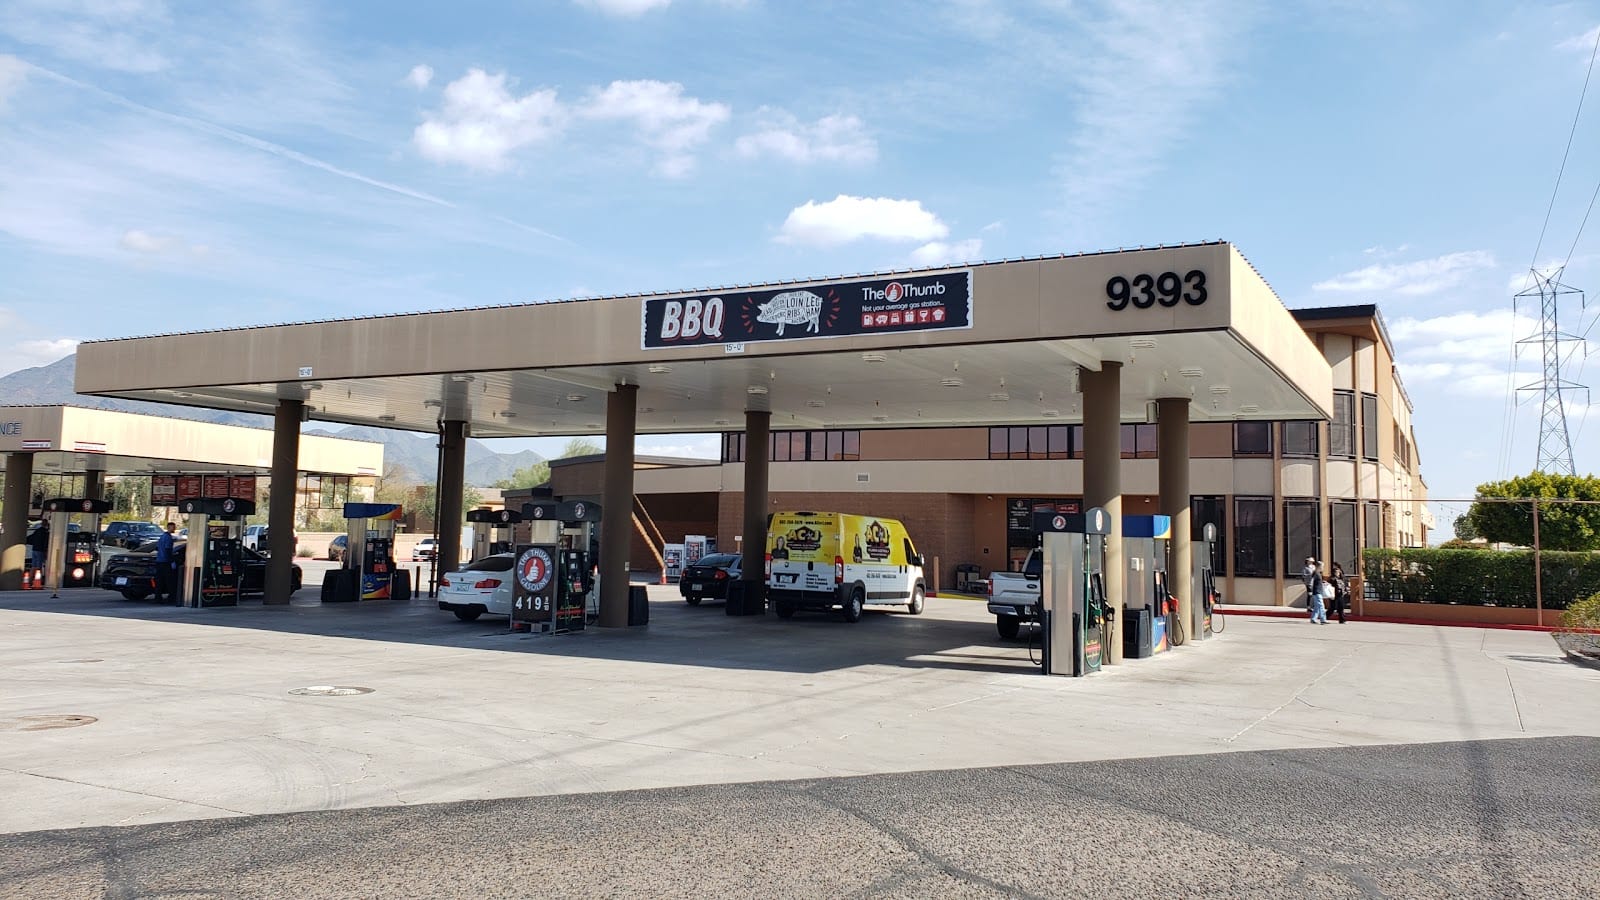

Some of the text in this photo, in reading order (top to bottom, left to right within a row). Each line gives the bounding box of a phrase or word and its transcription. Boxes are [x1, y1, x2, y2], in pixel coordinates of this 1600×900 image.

[861, 281, 946, 301] The Thumb
[1106, 269, 1208, 311] 9393
[786, 297, 804, 308] LOIN
[861, 305, 872, 313] Not
[873, 305, 885, 313] your
[885, 303, 908, 311] average
[909, 302, 920, 310] gas
[661, 297, 725, 340] BBQ
[786, 308, 801, 319] RIBS
[519, 549, 551, 566] THE THUMB
[520, 577, 548, 591] GASOLINE
